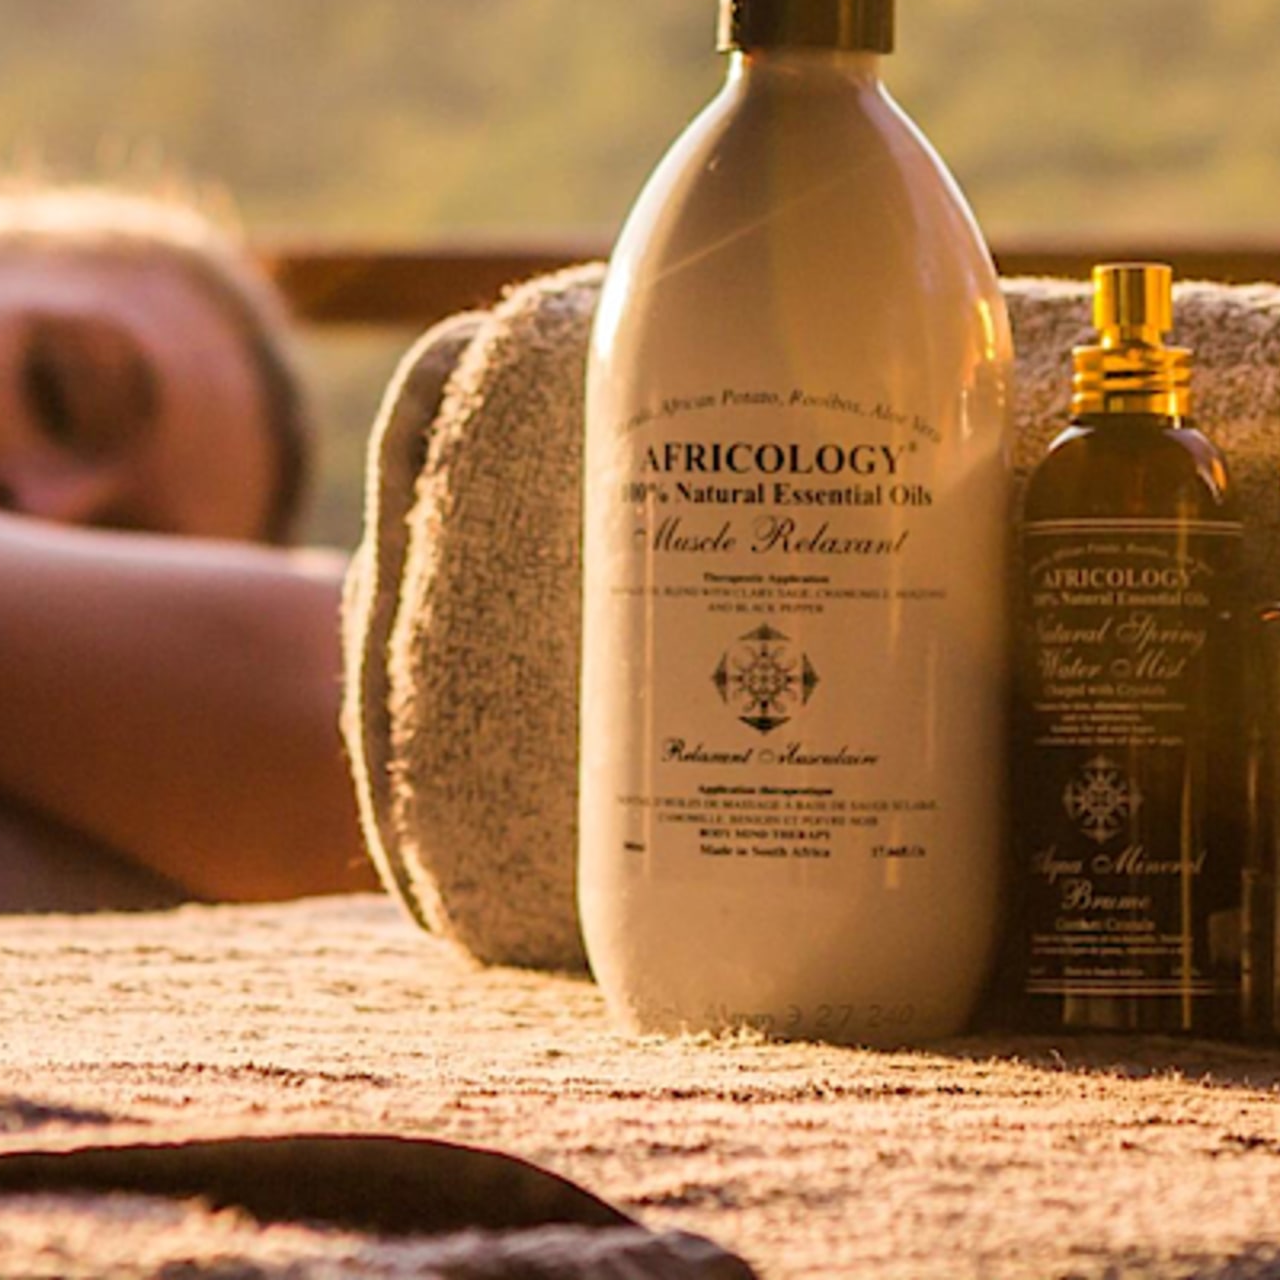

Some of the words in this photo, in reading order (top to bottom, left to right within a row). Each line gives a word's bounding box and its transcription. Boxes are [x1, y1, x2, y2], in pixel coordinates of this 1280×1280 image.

[675, 481, 765, 505] Natural
[773, 481, 883, 506] Essential
[889, 482, 934, 507] Oils
[633, 514, 737, 554] Muscle
[749, 514, 911, 555] Relaxant
[1041, 568, 1191, 588] AFRICOLOGY
[1116, 611, 1208, 656] Spring
[1037, 647, 1103, 678] Water
[1110, 647, 1187, 678] Mist
[700, 843, 733, 856] Made
[751, 844, 788, 857] South
